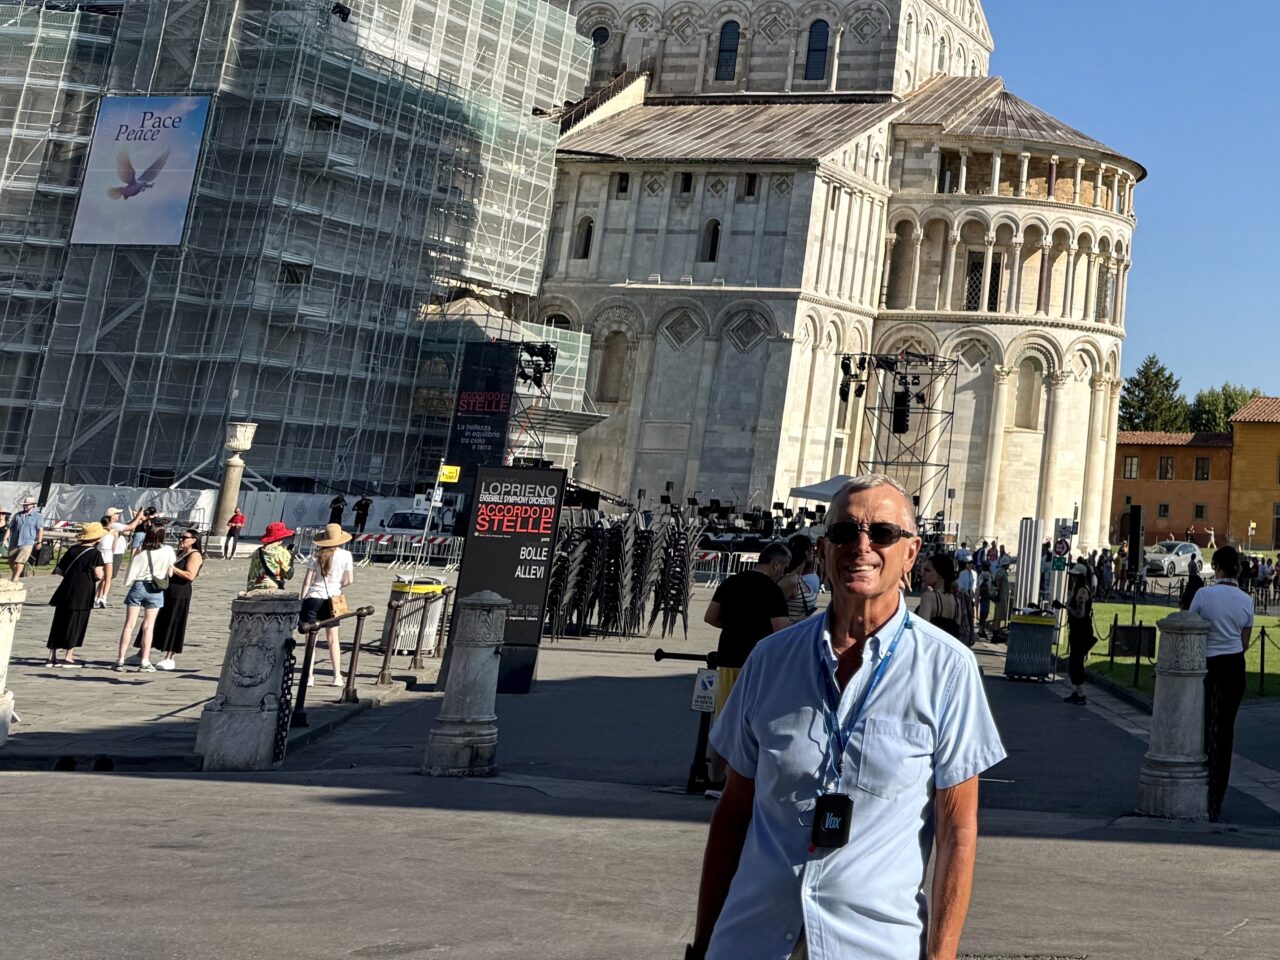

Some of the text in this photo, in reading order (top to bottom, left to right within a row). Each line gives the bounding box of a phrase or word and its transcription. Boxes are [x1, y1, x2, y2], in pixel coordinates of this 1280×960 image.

[139, 111, 182, 129] Pace
[114, 124, 160, 141] Peace
[460, 391, 510, 401] ACCORDO DI
[459, 400, 509, 412] STELLE
[480, 482, 558, 498] LOPRIENO
[479, 494, 555, 506] ENSEMBLE SYMPHONY ORCHESTRA
[541, 507, 555, 518] DI
[475, 515, 553, 534] STELLE
[519, 546, 548, 560] BOLLE
[514, 565, 545, 579] ALLEVI
[825, 812, 842, 829] Vox
